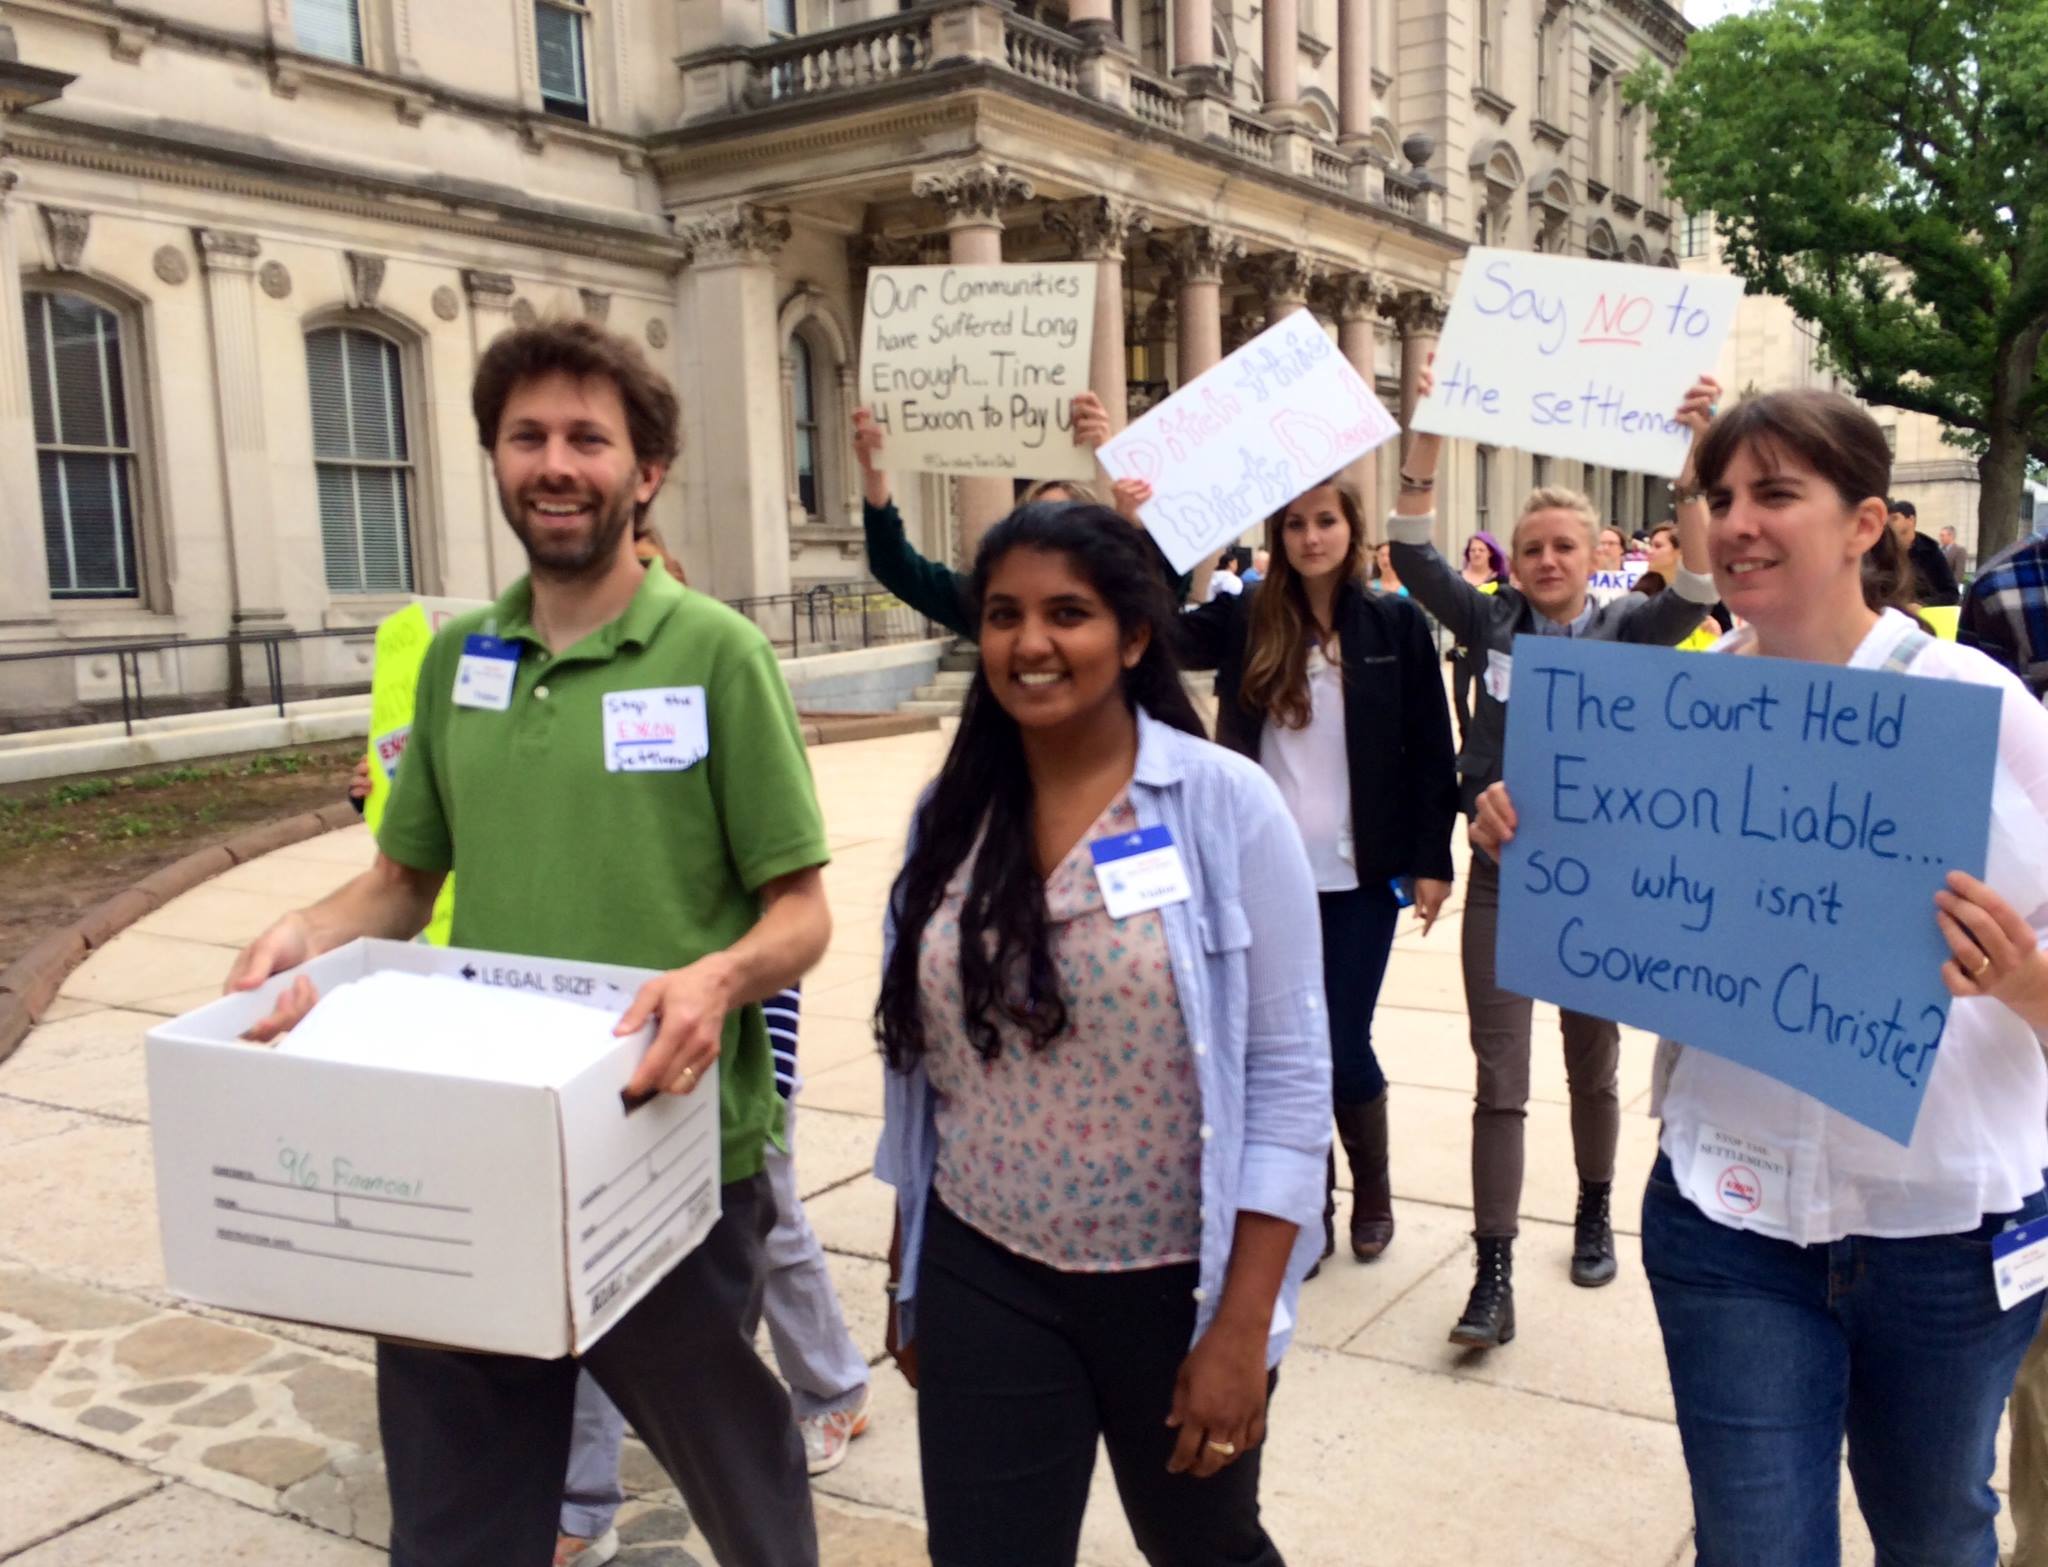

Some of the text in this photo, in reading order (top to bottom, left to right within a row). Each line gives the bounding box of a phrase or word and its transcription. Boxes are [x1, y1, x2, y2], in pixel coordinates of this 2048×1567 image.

[869, 269, 1080, 319] Our Communities
[876, 306, 1079, 351] have Suffered Long
[1473, 261, 1710, 355] Say NO to
[871, 351, 1066, 400] Enough... Time
[1111, 331, 1331, 487] Ditch this
[1441, 361, 1691, 442] the settlemen
[871, 394, 1074, 448] 4 Exxon to Pay U
[1155, 448, 1295, 550] Dirty
[1533, 667, 1636, 732] The
[1663, 671, 1780, 733] Court
[1803, 681, 1906, 750] Held
[1553, 754, 1944, 866] Exxon Liable...
[1631, 856, 1715, 932] why
[1756, 879, 1844, 925] isn't
[481, 967, 546, 991] LEGAL
[1558, 917, 1946, 1088] Governor Christie?
[332, 1156, 424, 1198] Financial
